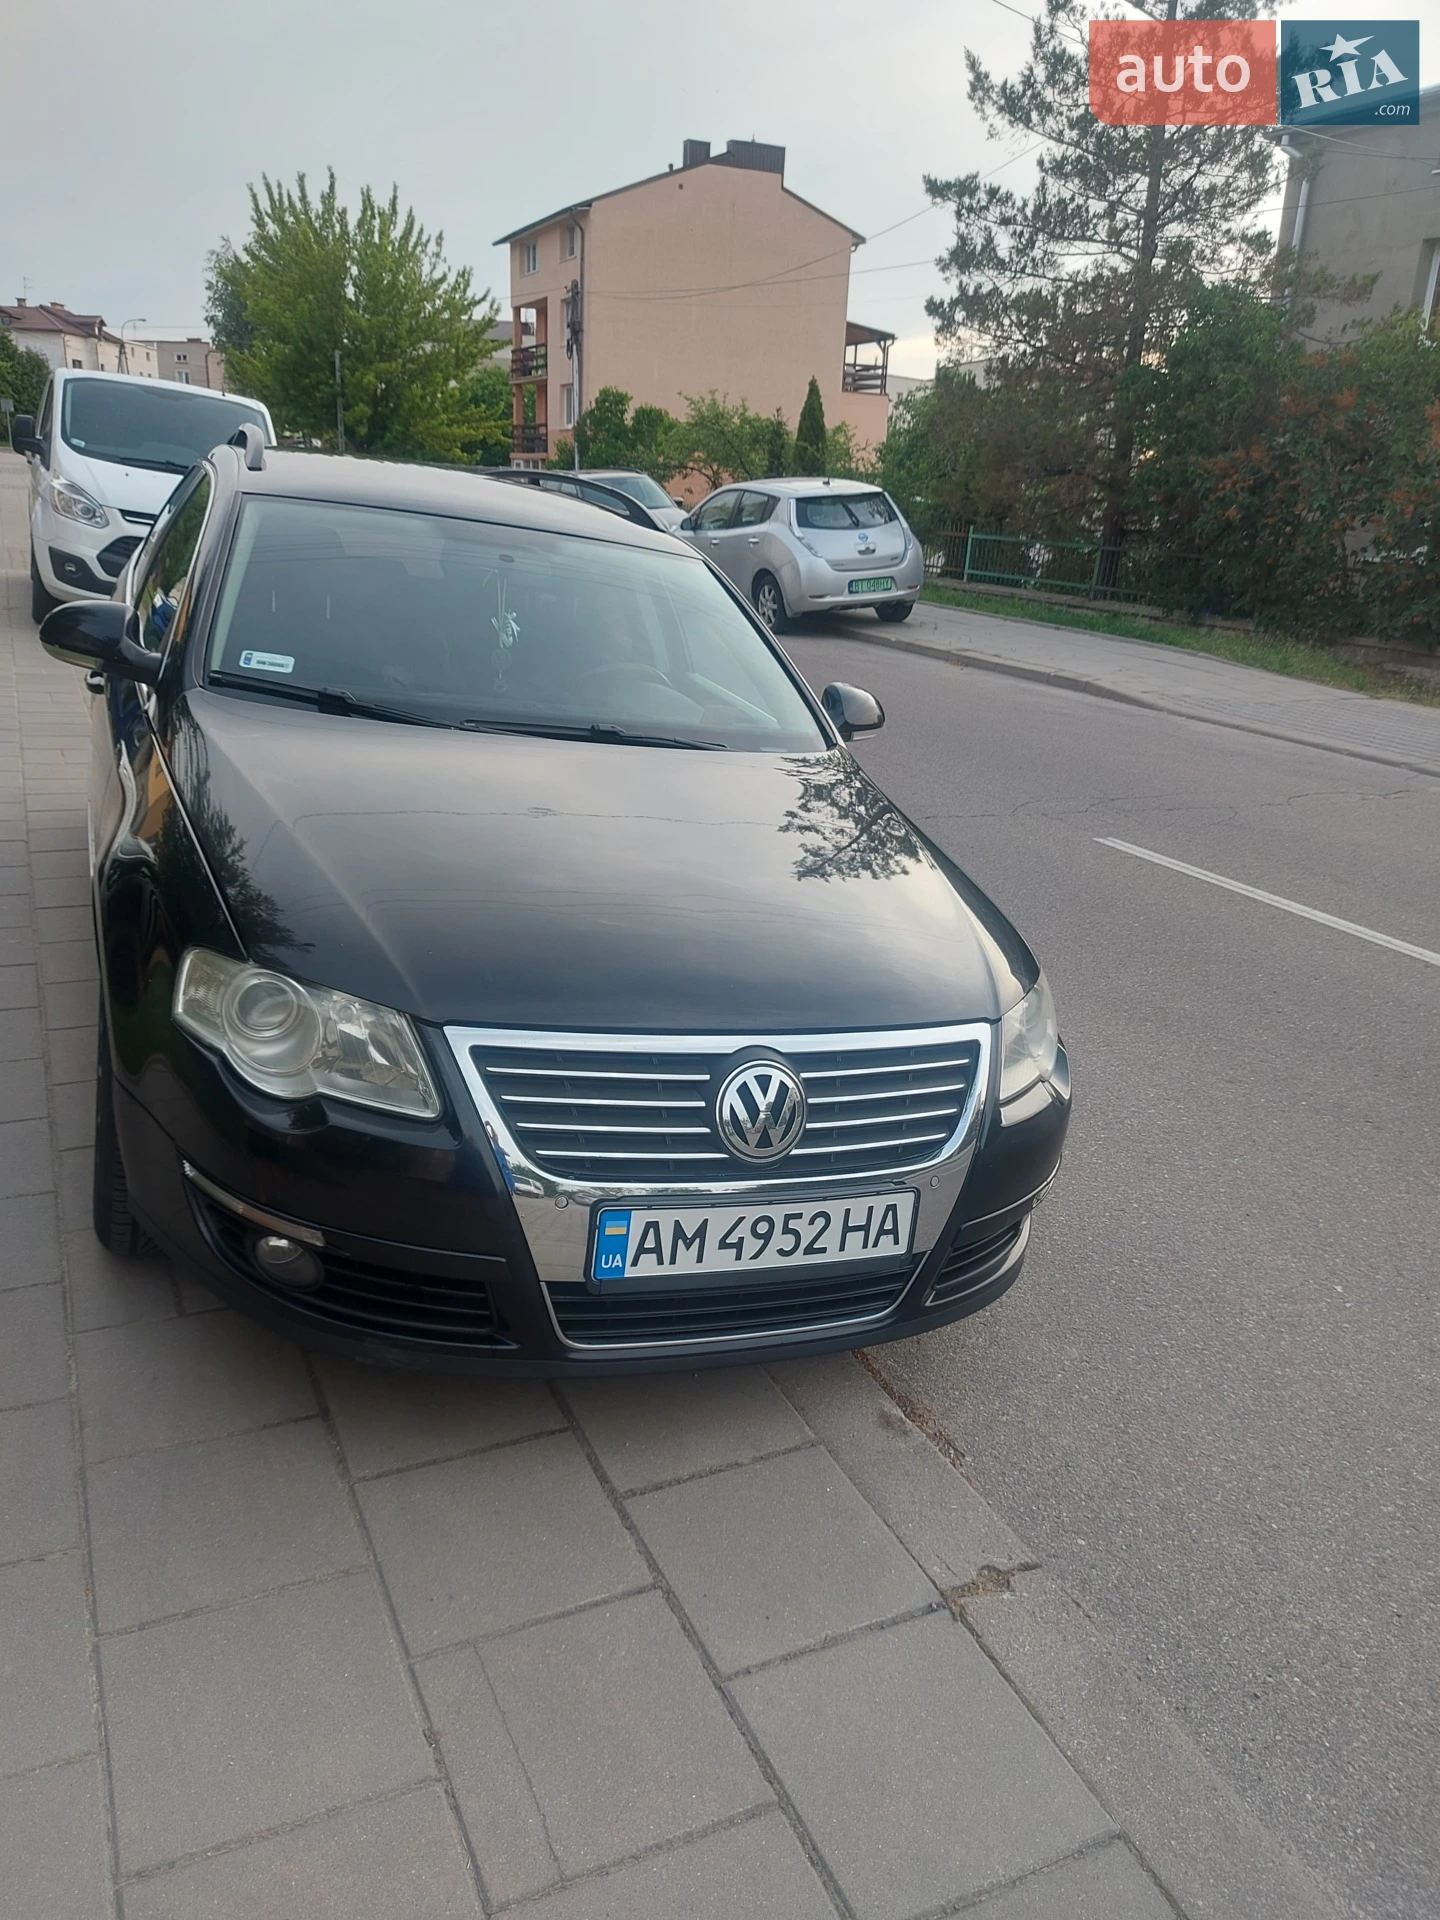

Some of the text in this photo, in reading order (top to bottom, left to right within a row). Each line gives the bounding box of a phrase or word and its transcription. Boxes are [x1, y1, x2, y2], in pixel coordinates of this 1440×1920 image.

[722, 1066, 803, 1157] VW
[601, 1254, 623, 1269] UA
[630, 1203, 900, 1267] AM 4952 HA
